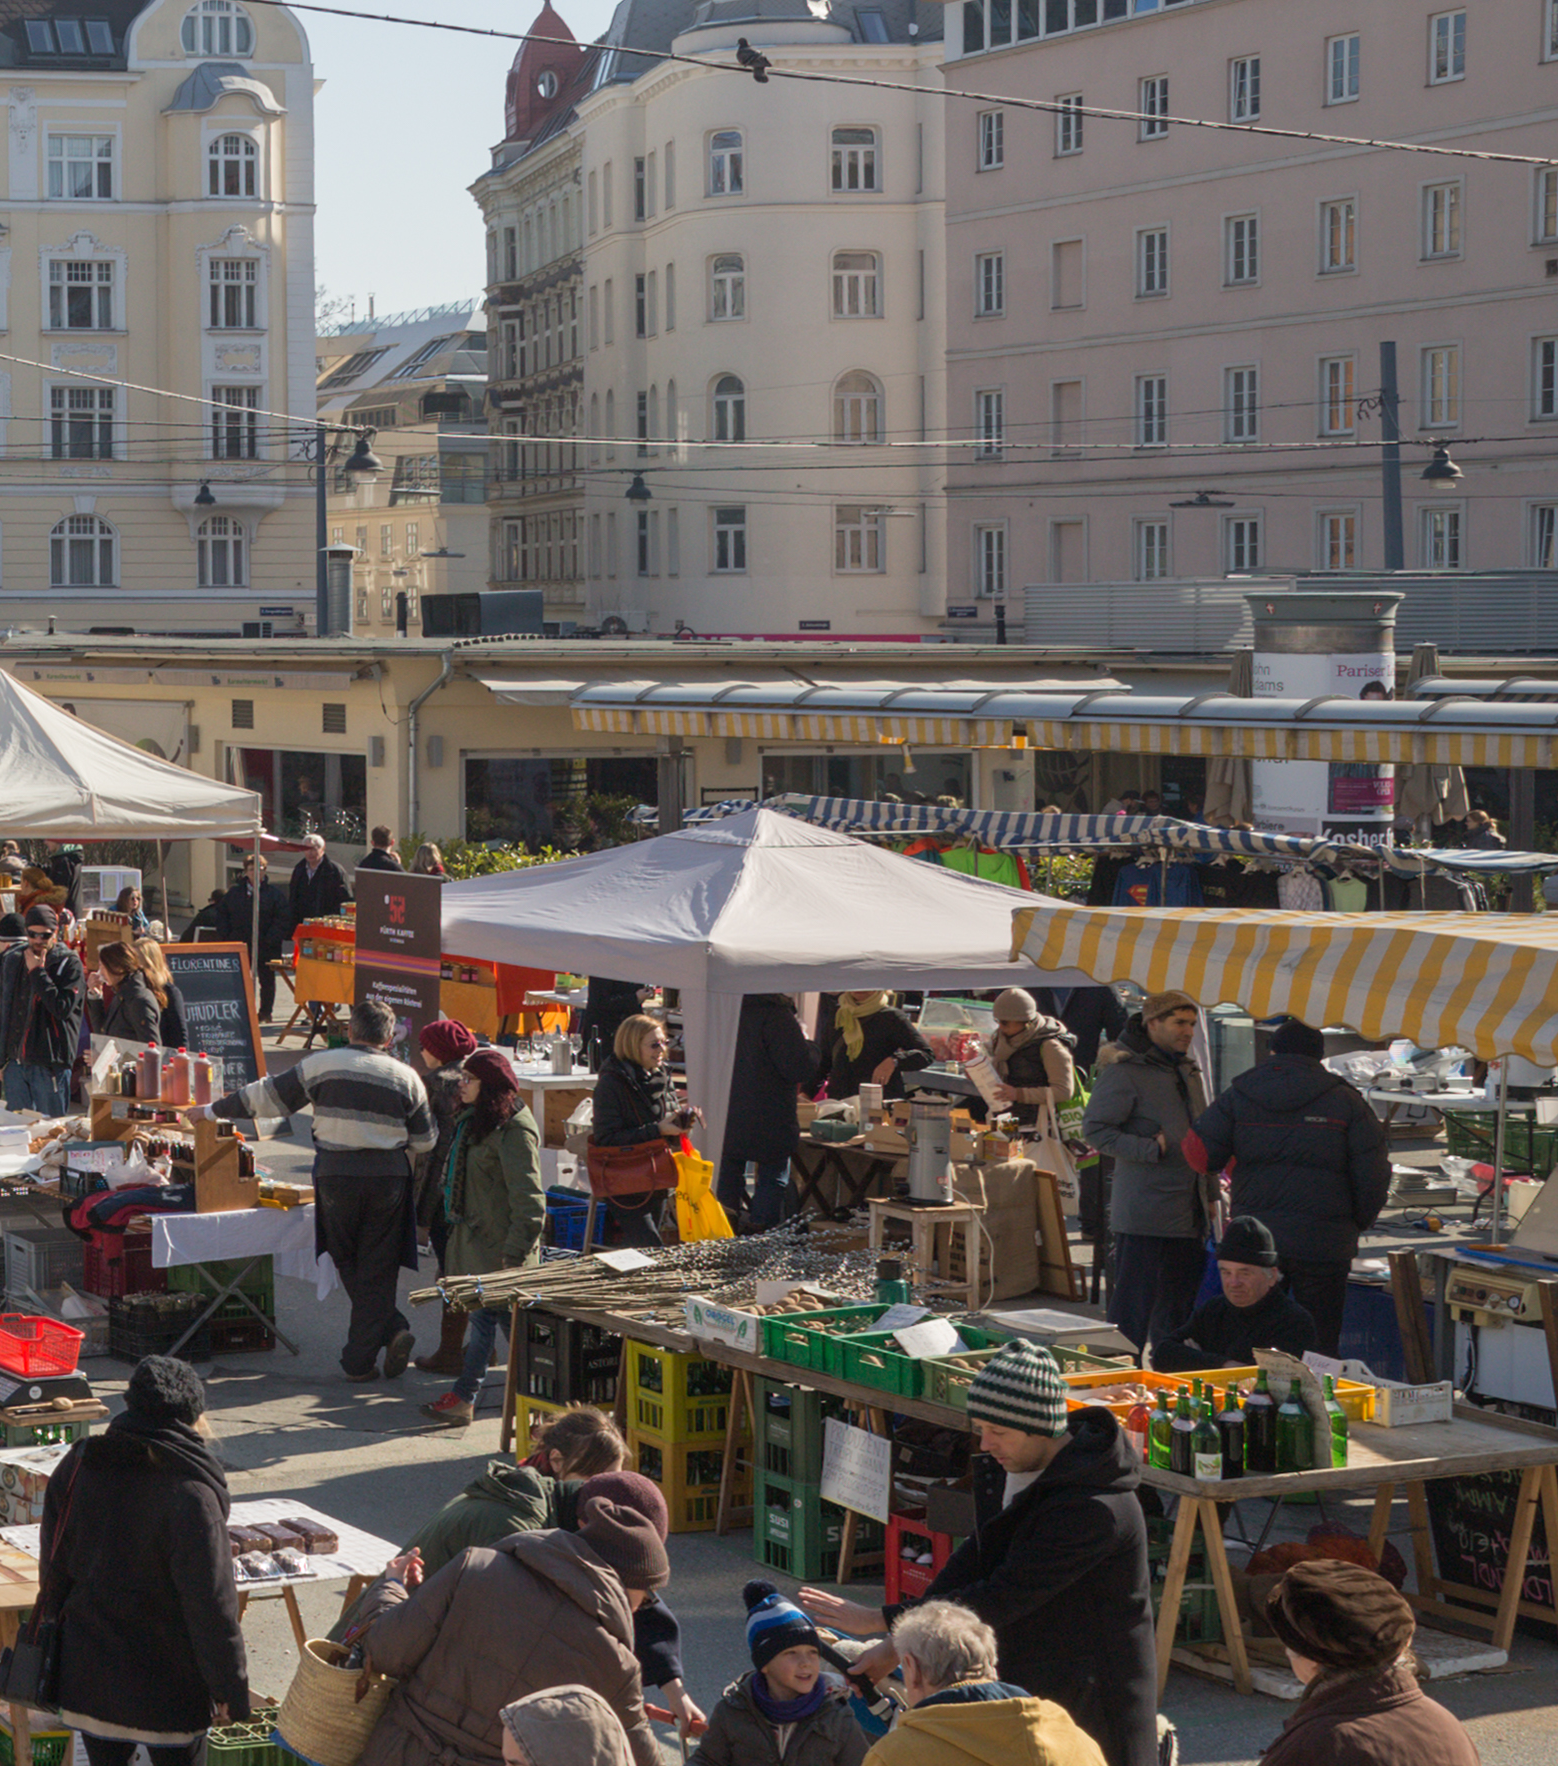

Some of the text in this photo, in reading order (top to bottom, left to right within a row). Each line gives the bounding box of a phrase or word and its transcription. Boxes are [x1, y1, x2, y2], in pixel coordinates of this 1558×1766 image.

[1337, 664, 1384, 677] Pariser
[170, 957, 240, 971] FLORENTINER
[769, 1513, 871, 1542] SUSI SSI
